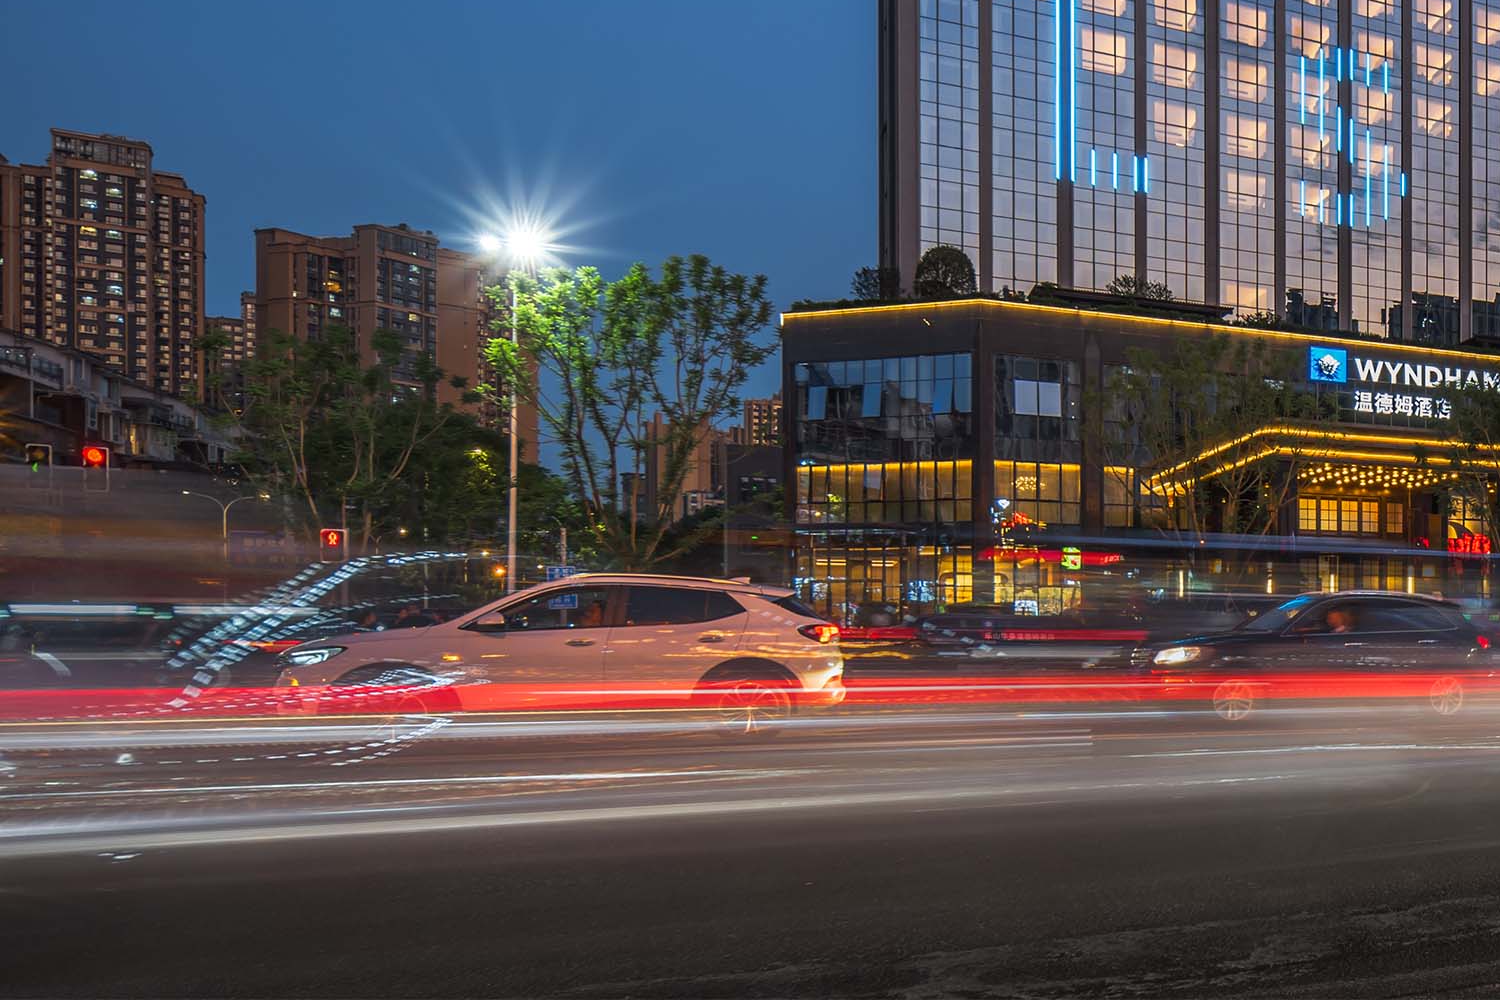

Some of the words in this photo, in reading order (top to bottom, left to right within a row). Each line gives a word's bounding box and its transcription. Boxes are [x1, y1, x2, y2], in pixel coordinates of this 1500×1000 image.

[1354, 390, 1452, 420] 温德姆酒店
